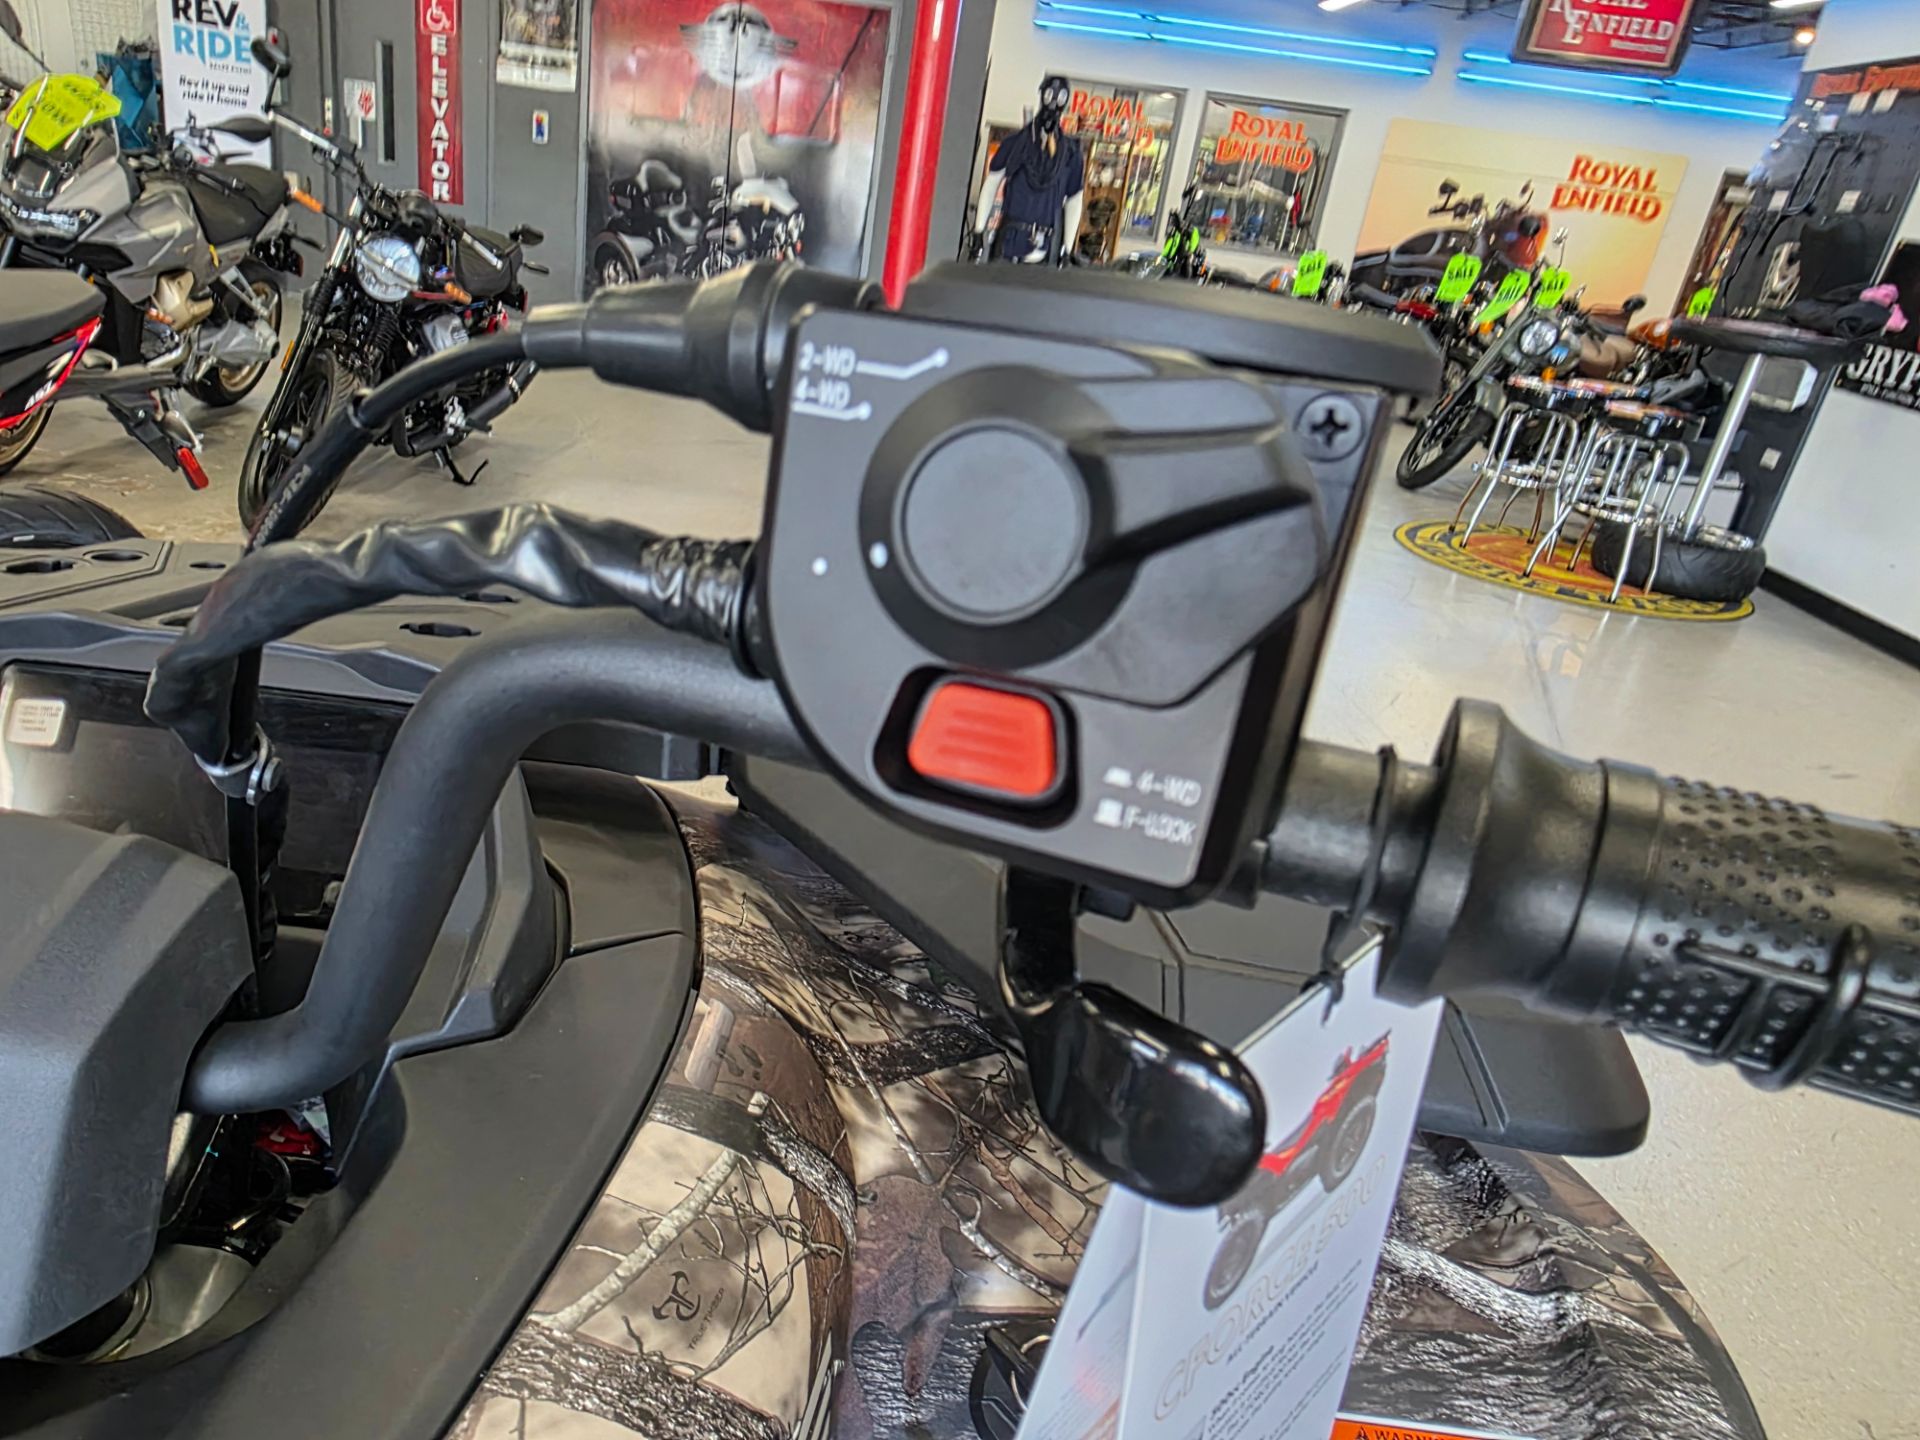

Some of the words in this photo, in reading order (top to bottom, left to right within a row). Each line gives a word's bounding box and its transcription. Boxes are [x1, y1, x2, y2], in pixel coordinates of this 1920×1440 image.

[172, 0, 238, 29] REV
[1562, 9, 1675, 45] ENFIELD
[173, 24, 252, 64] RIDE
[182, 90, 204, 101] ride
[217, 92, 248, 109] home
[229, 85, 250, 97] and
[1070, 90, 1146, 125] ROYAL
[431, 34, 451, 201] ELEVATOR
[1229, 110, 1307, 145] ROYAL
[1215, 136, 1313, 175] ENFIELD
[1568, 154, 1657, 192] ROYAL
[1550, 183, 1662, 223] ENFIELD
[1448, 267, 1474, 281] SALE
[800, 340, 856, 378] 2-WD
[795, 375, 851, 410] 4-WD
[1136, 768, 1202, 807] 4-WD
[687, 1322, 708, 1350] TRUE
